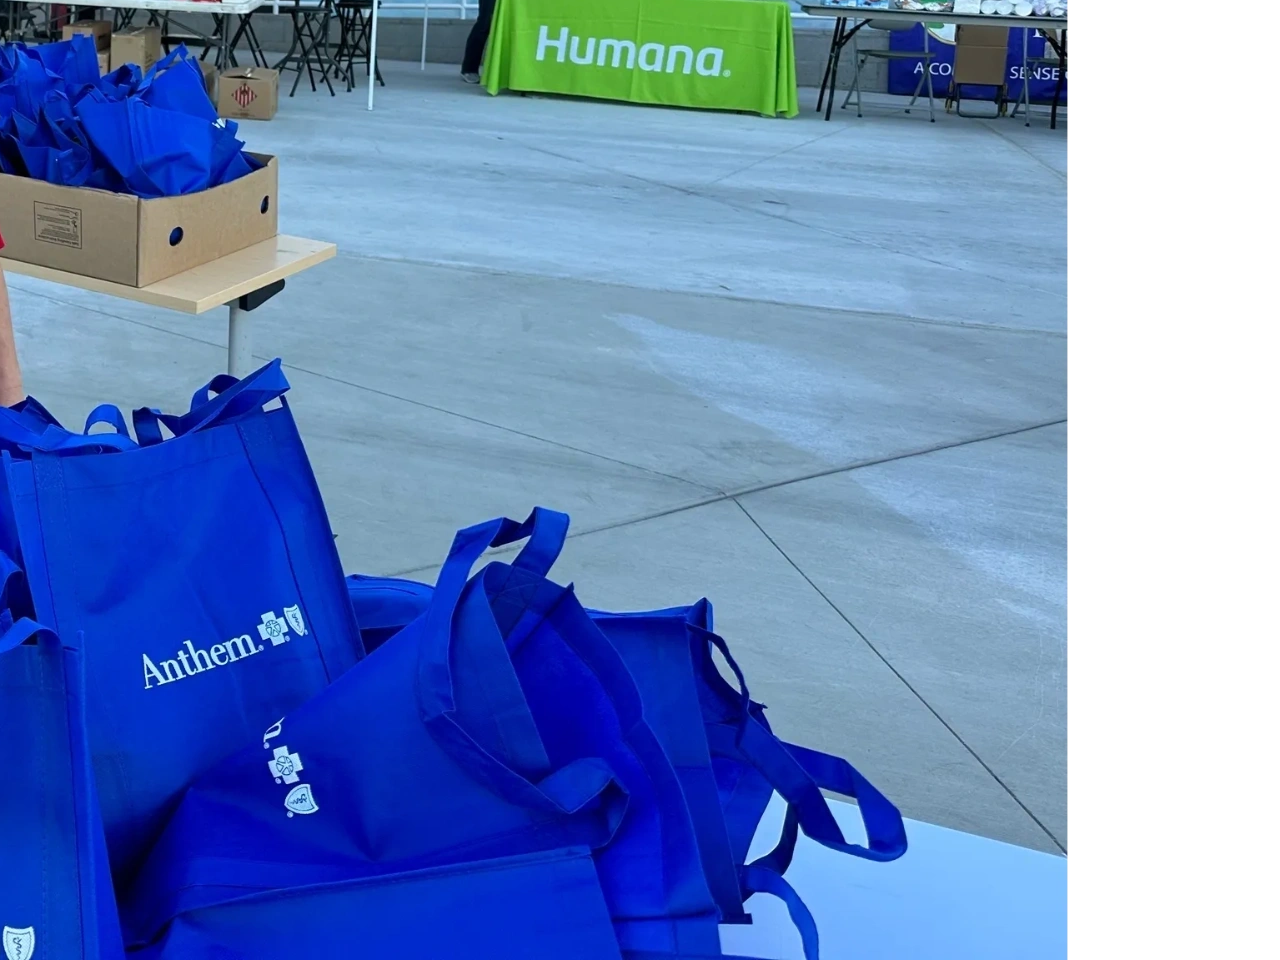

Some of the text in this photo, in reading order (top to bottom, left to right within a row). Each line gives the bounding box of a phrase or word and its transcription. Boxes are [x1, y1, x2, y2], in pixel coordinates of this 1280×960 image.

[536, 24, 724, 77] Humana
[1009, 66, 1060, 80] SENSE
[142, 634, 260, 689] Anthem
